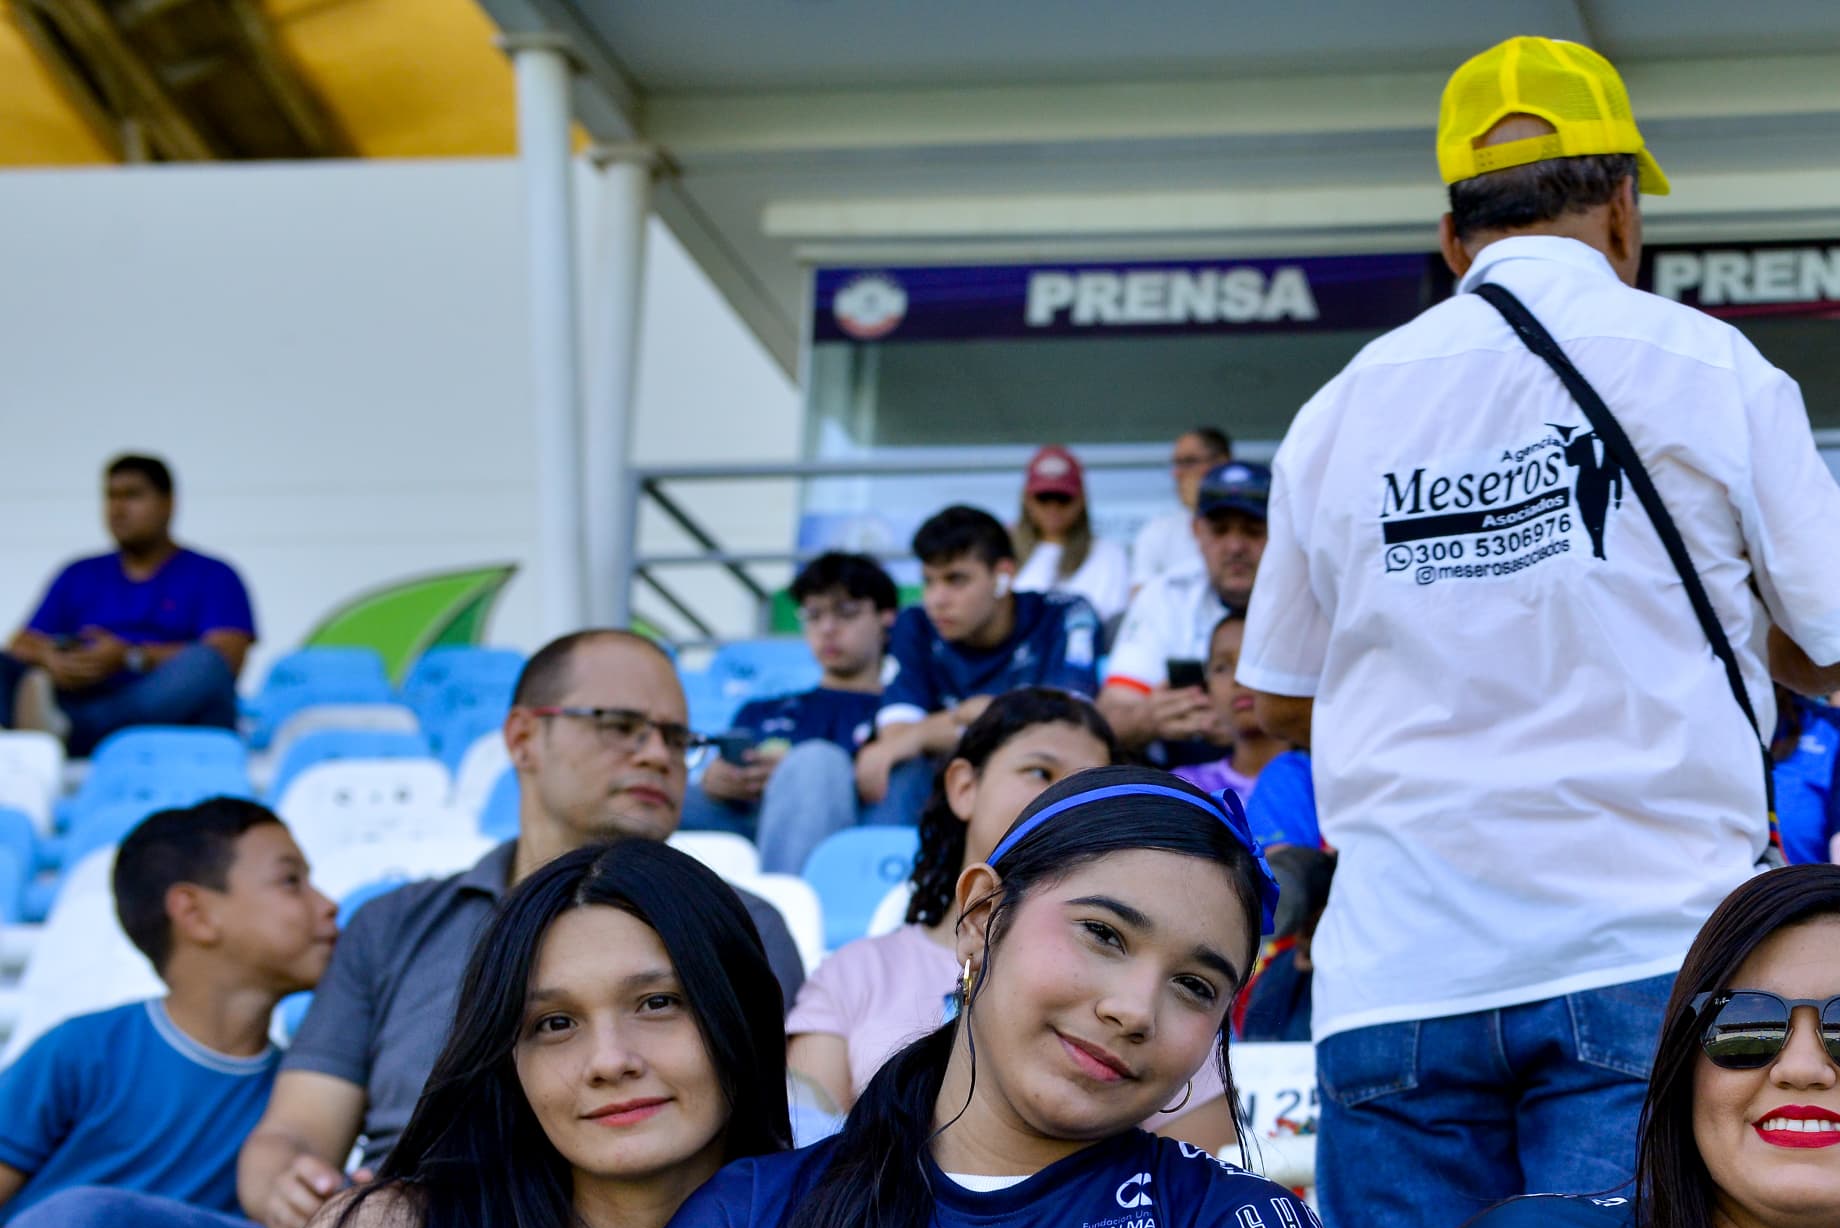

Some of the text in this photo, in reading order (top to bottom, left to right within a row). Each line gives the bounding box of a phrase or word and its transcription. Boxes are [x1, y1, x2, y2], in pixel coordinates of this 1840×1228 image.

[1025, 266, 1319, 326] PRENSA
[1380, 451, 1561, 518] Meseros
[1482, 493, 1566, 529] Asociados
[1416, 513, 1571, 564] 300 5306976
